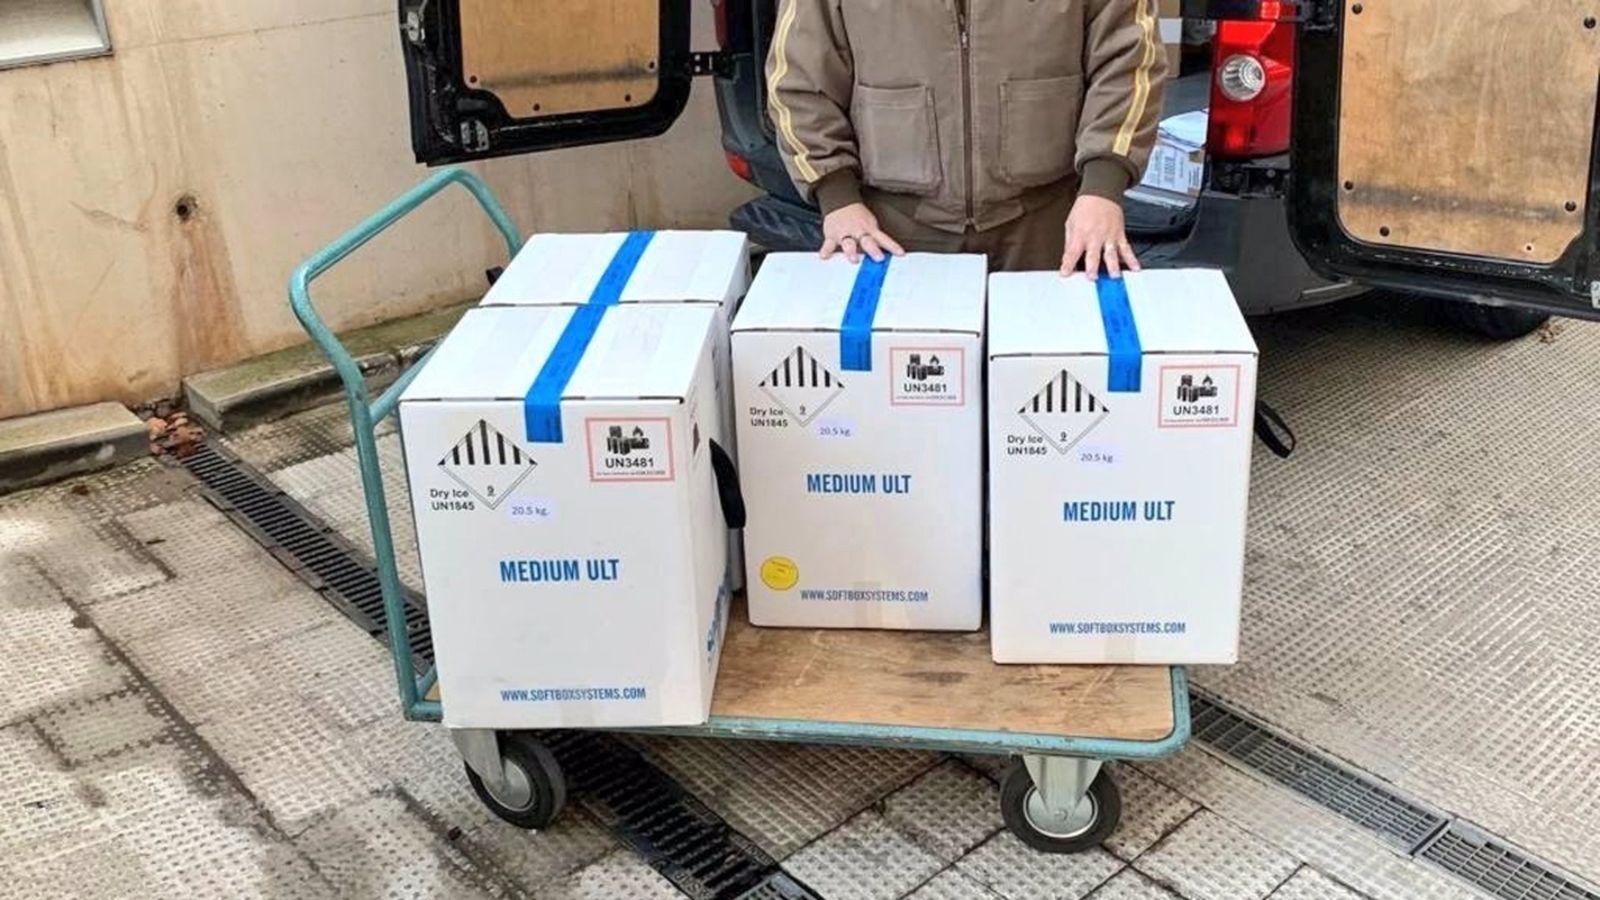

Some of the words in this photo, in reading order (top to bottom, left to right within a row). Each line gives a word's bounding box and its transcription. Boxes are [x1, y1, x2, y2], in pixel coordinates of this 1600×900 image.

[903, 382, 947, 393] UN3481
[749, 407, 767, 417] Dry
[769, 407, 784, 416] Ice
[1172, 404, 1219, 416] UN3481
[750, 418, 789, 427] UN1845
[819, 427, 838, 436] 20.5
[1007, 434, 1025, 445] Dry
[1028, 434, 1044, 443] Ice
[1007, 446, 1048, 455] UN1845
[1080, 453, 1101, 462] 20.5
[605, 458, 654, 469] UN3481
[806, 473, 876, 494] MEDIUM
[882, 473, 911, 493] ULT
[429, 488, 450, 500] Dry
[452, 488, 469, 498] Ice
[431, 501, 475, 511] UN1845
[511, 505, 533, 516] 20.5
[1063, 501, 1137, 522] MEDIUM
[1143, 500, 1176, 521] ULT
[499, 559, 580, 583] MEDIUM
[585, 558, 620, 582] ULT
[800, 589, 929, 602] WWW.SOFTBOXSYSTEMS.COM
[1049, 621, 1186, 635] WWW.SOFTBOXSYSTEMS.COM
[500, 687, 647, 702] WWW.SOFTBOXSYSTEMS.COM
